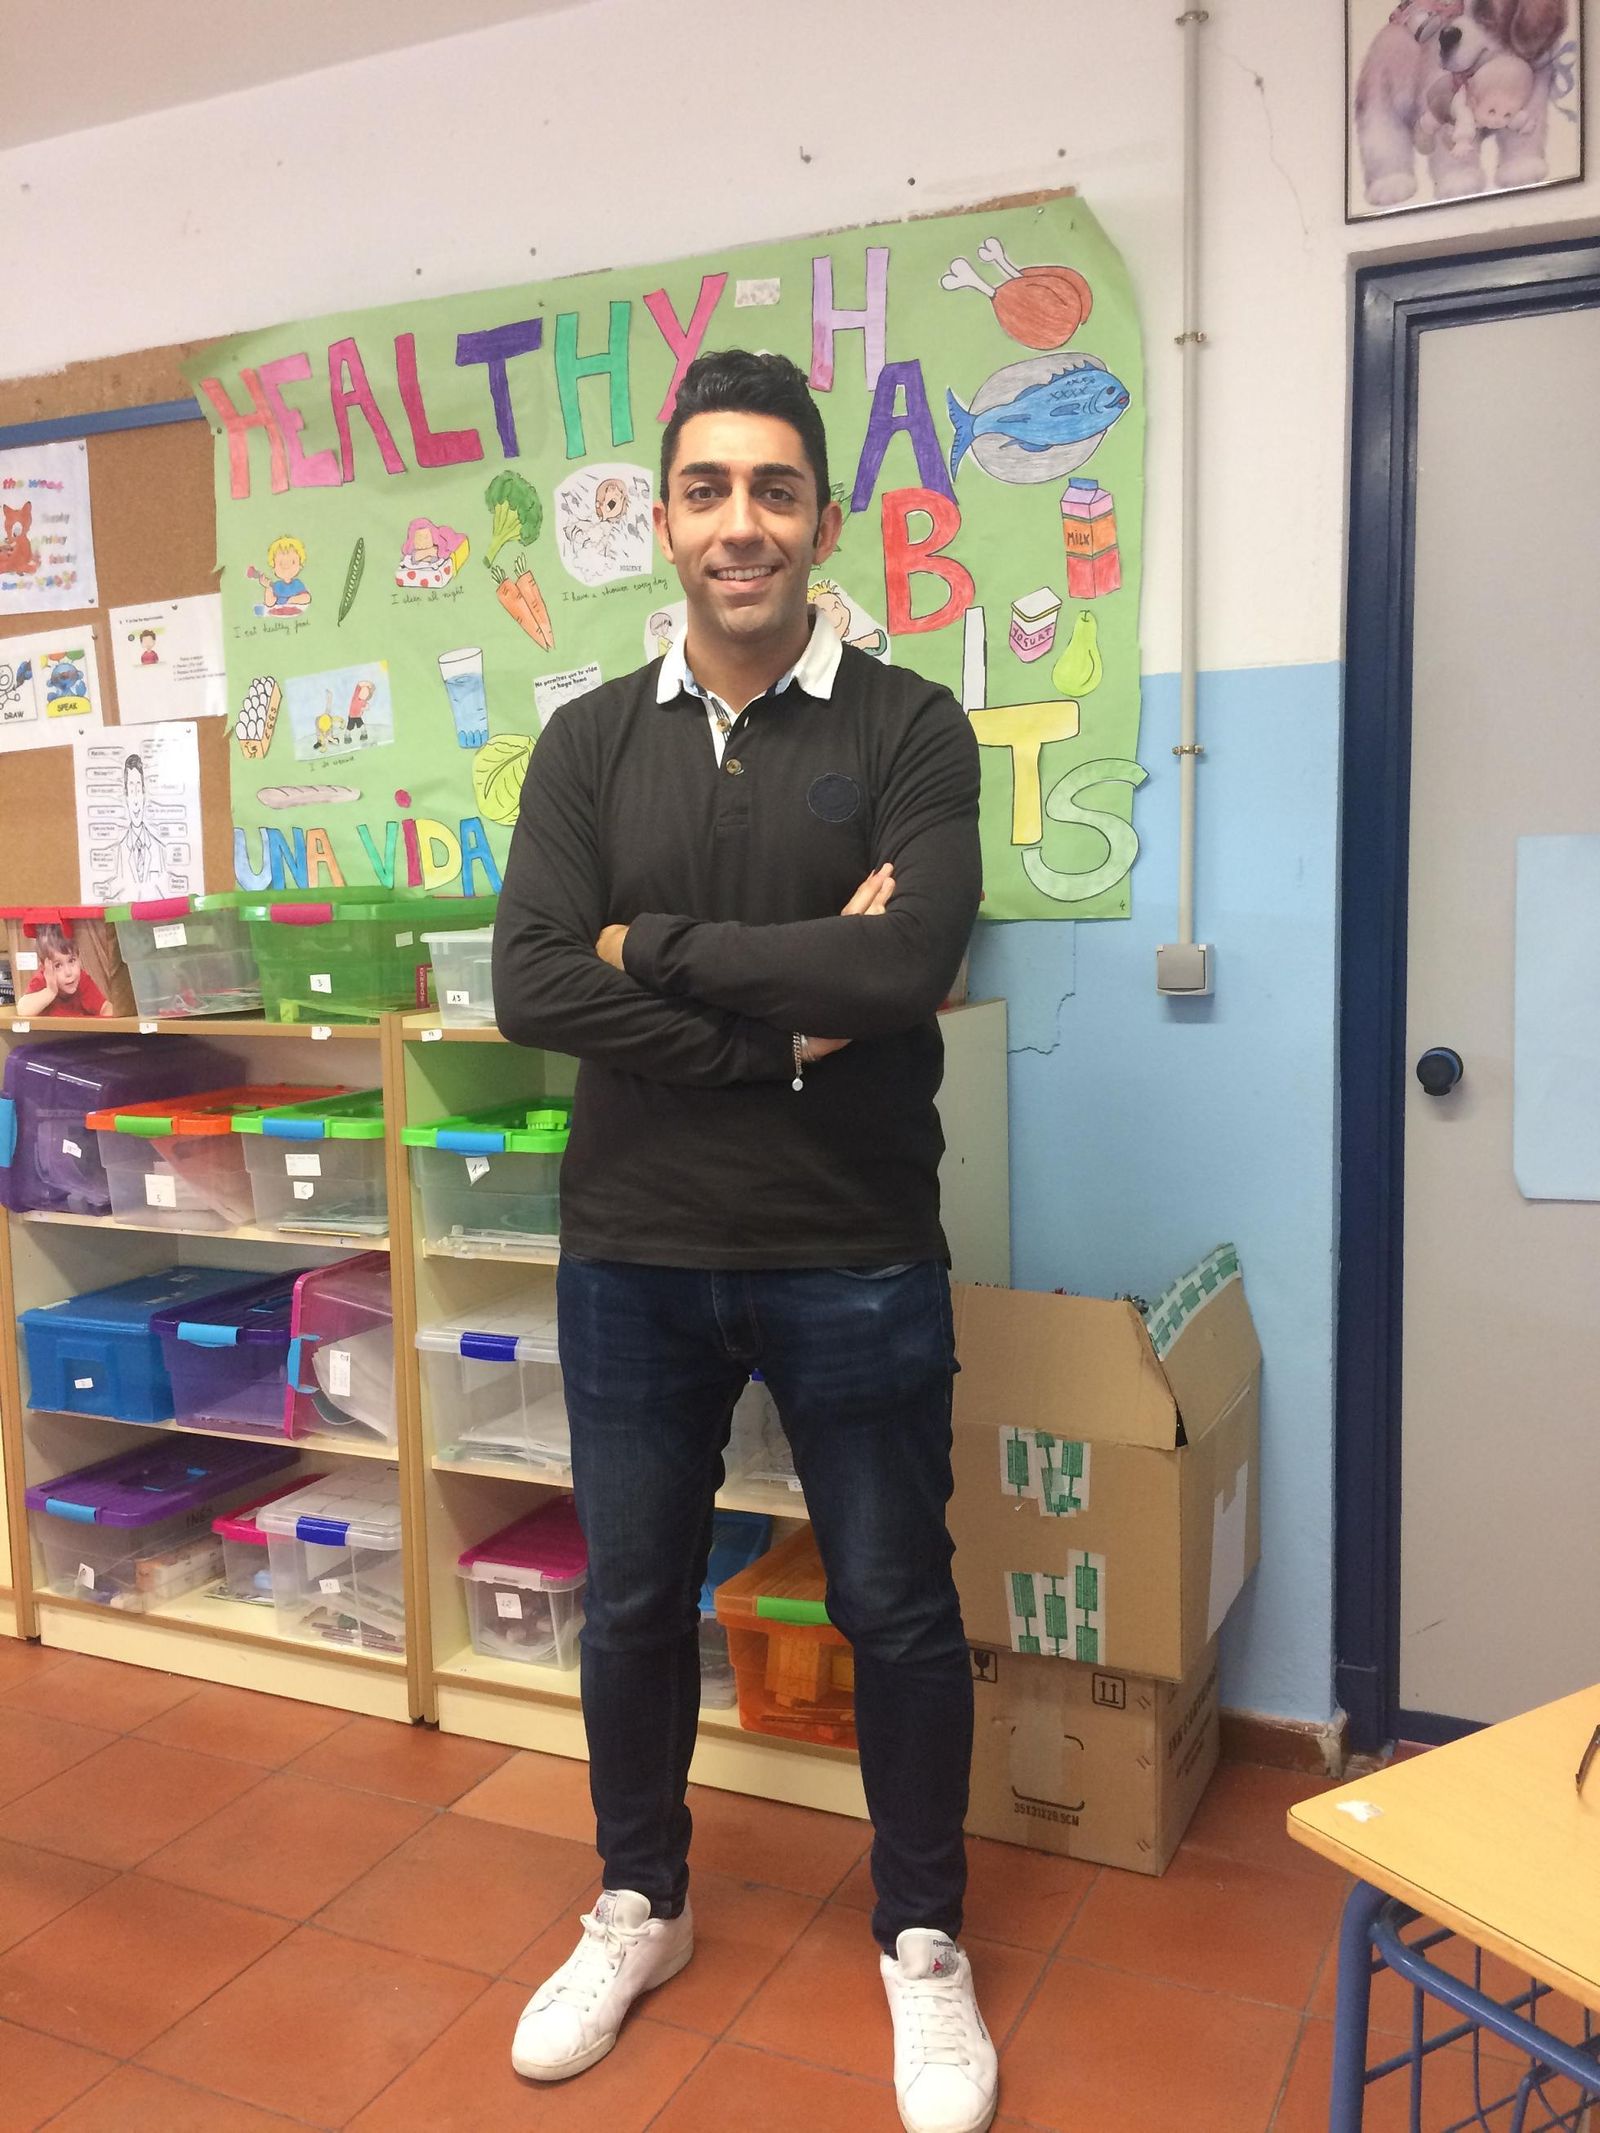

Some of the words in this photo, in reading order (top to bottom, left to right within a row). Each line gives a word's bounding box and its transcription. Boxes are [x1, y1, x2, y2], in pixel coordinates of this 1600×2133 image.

[199, 272, 728, 499] HEALTHY
[809, 246, 1149, 902] HABITS
[392, 594, 399, 605] I
[562, 592, 569, 601] I
[571, 592, 589, 602] have
[233, 627, 241, 639] I
[263, 623, 290, 636] healthy
[1012, 626, 1053, 648] YOGURT
[585, 666, 598, 674] vida
[57, 702, 78, 712] SPEAK
[4, 711, 24, 720] DRAW
[233, 826, 347, 891] UNA
